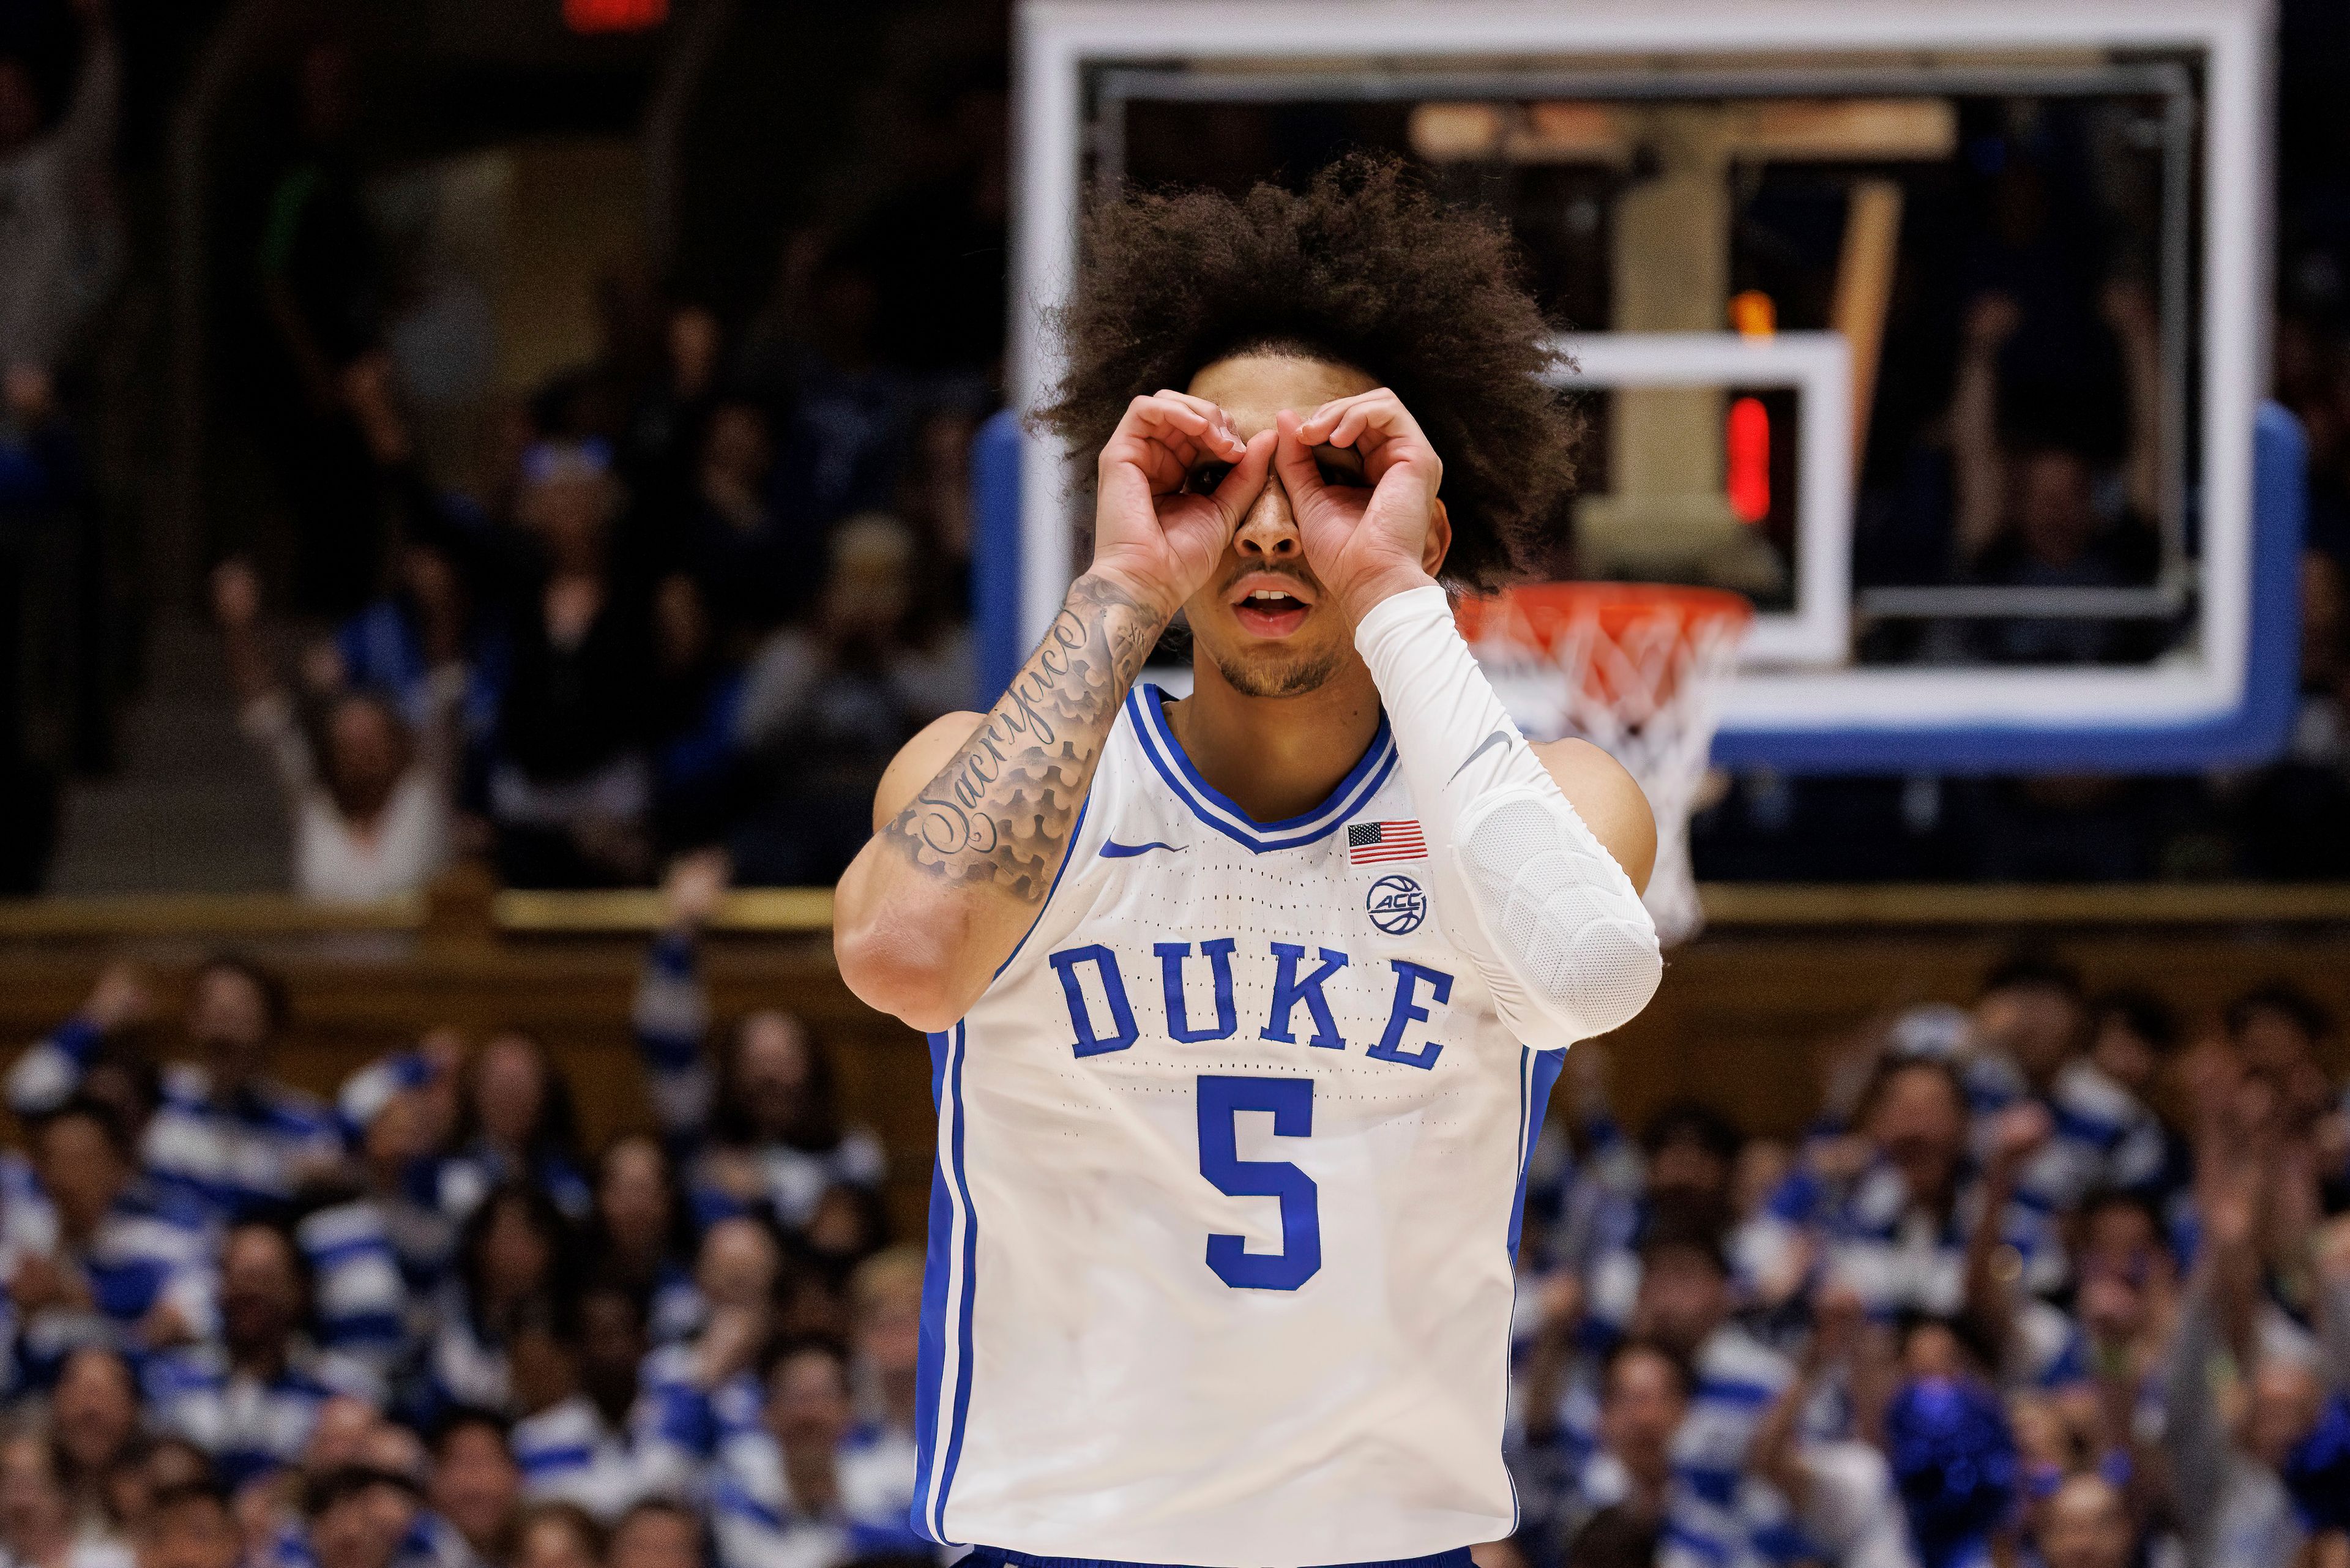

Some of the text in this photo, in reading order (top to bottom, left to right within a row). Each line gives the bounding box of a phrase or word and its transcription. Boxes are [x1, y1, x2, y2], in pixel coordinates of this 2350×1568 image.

[918, 610, 1086, 854] Sacrifice
[1375, 893, 1422, 909] ACC
[1049, 938, 1455, 1070] DUKE
[1197, 1075, 1322, 1291] 5
